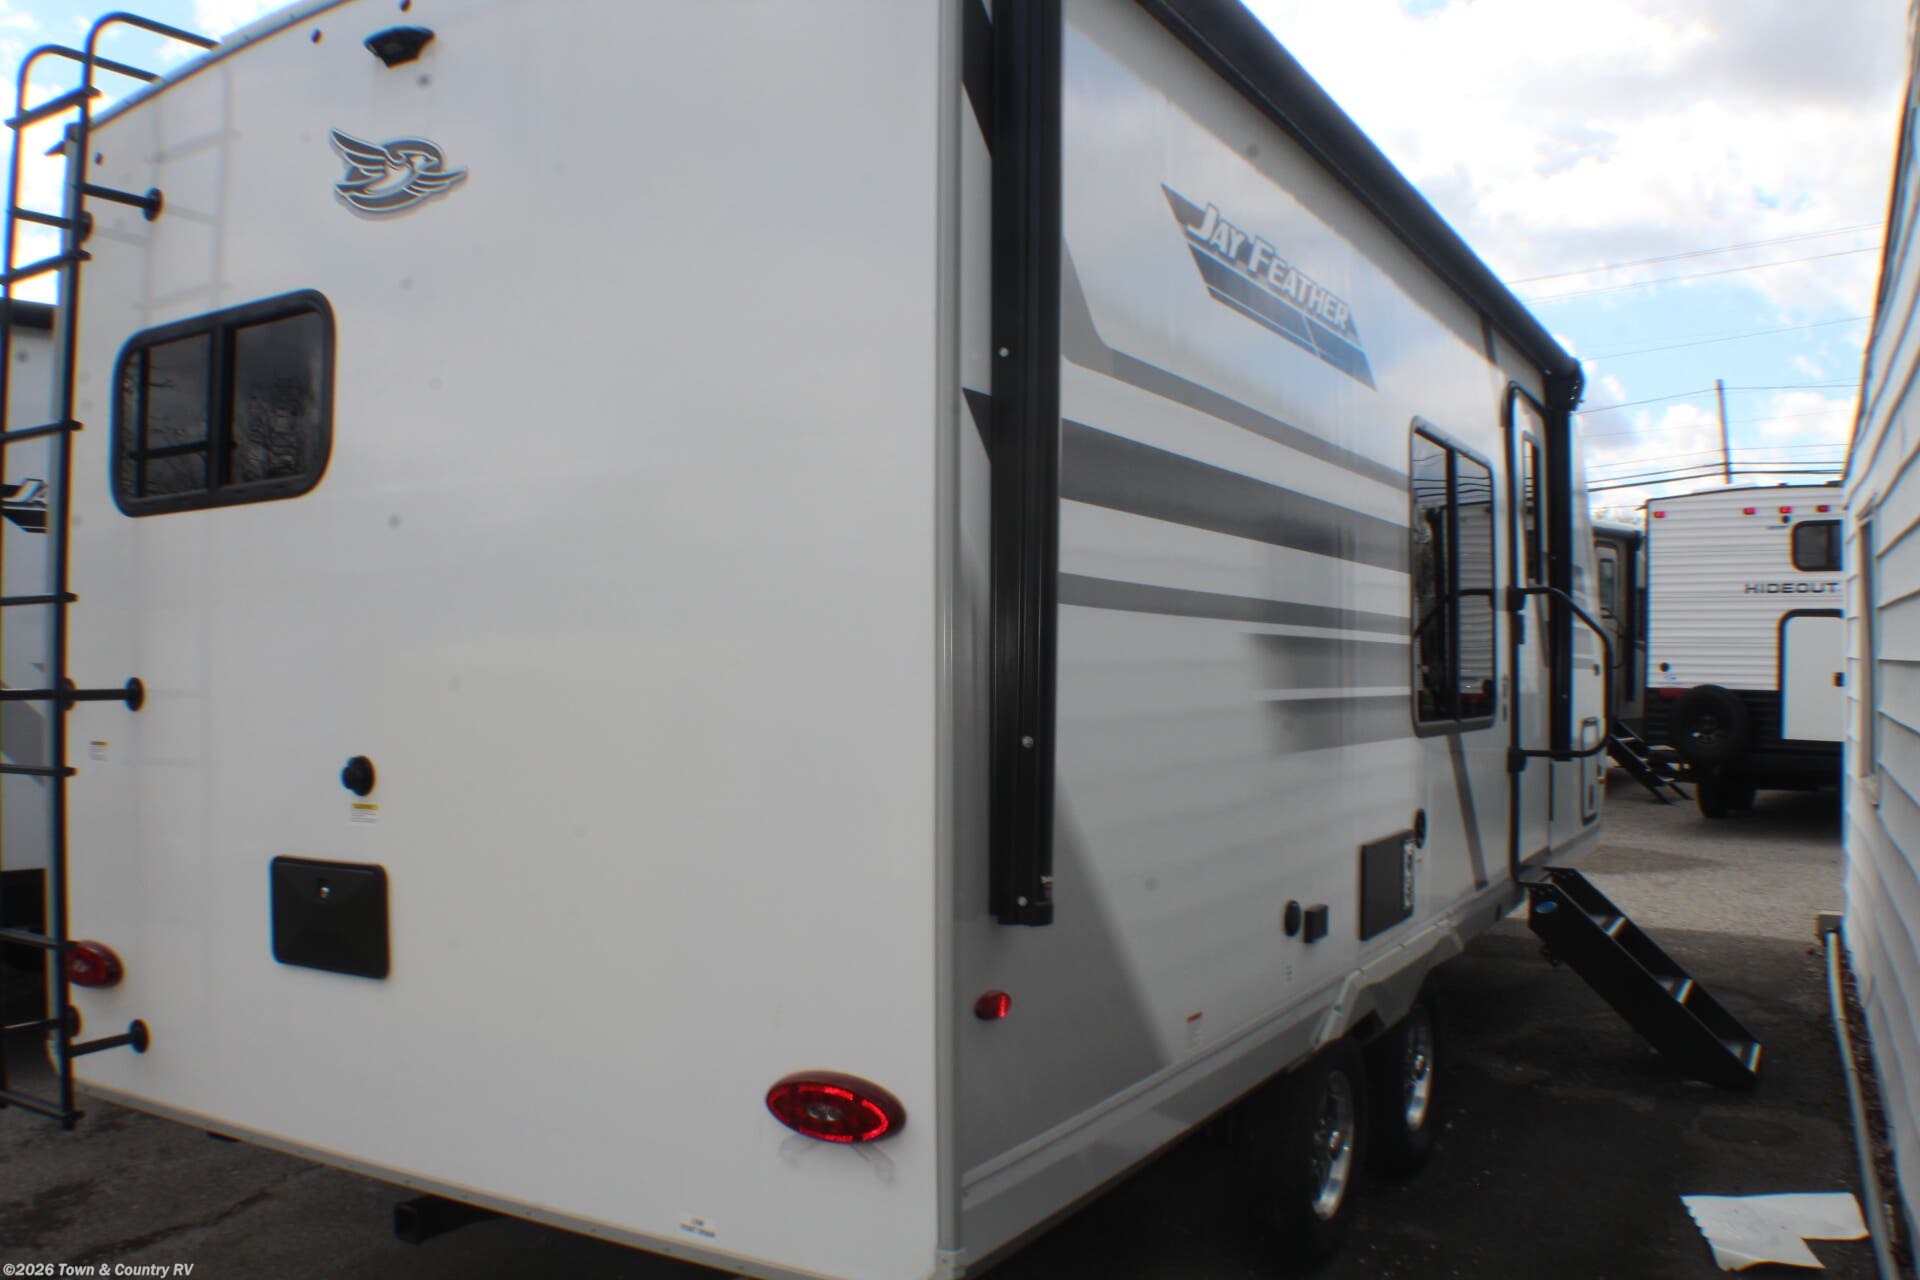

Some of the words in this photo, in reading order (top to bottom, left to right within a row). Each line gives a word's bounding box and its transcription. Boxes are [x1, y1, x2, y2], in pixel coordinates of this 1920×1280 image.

[1185, 202, 1249, 260] JAY
[1248, 235, 1351, 330] FEATHER
[1743, 582, 1840, 594] HIDEOUT
